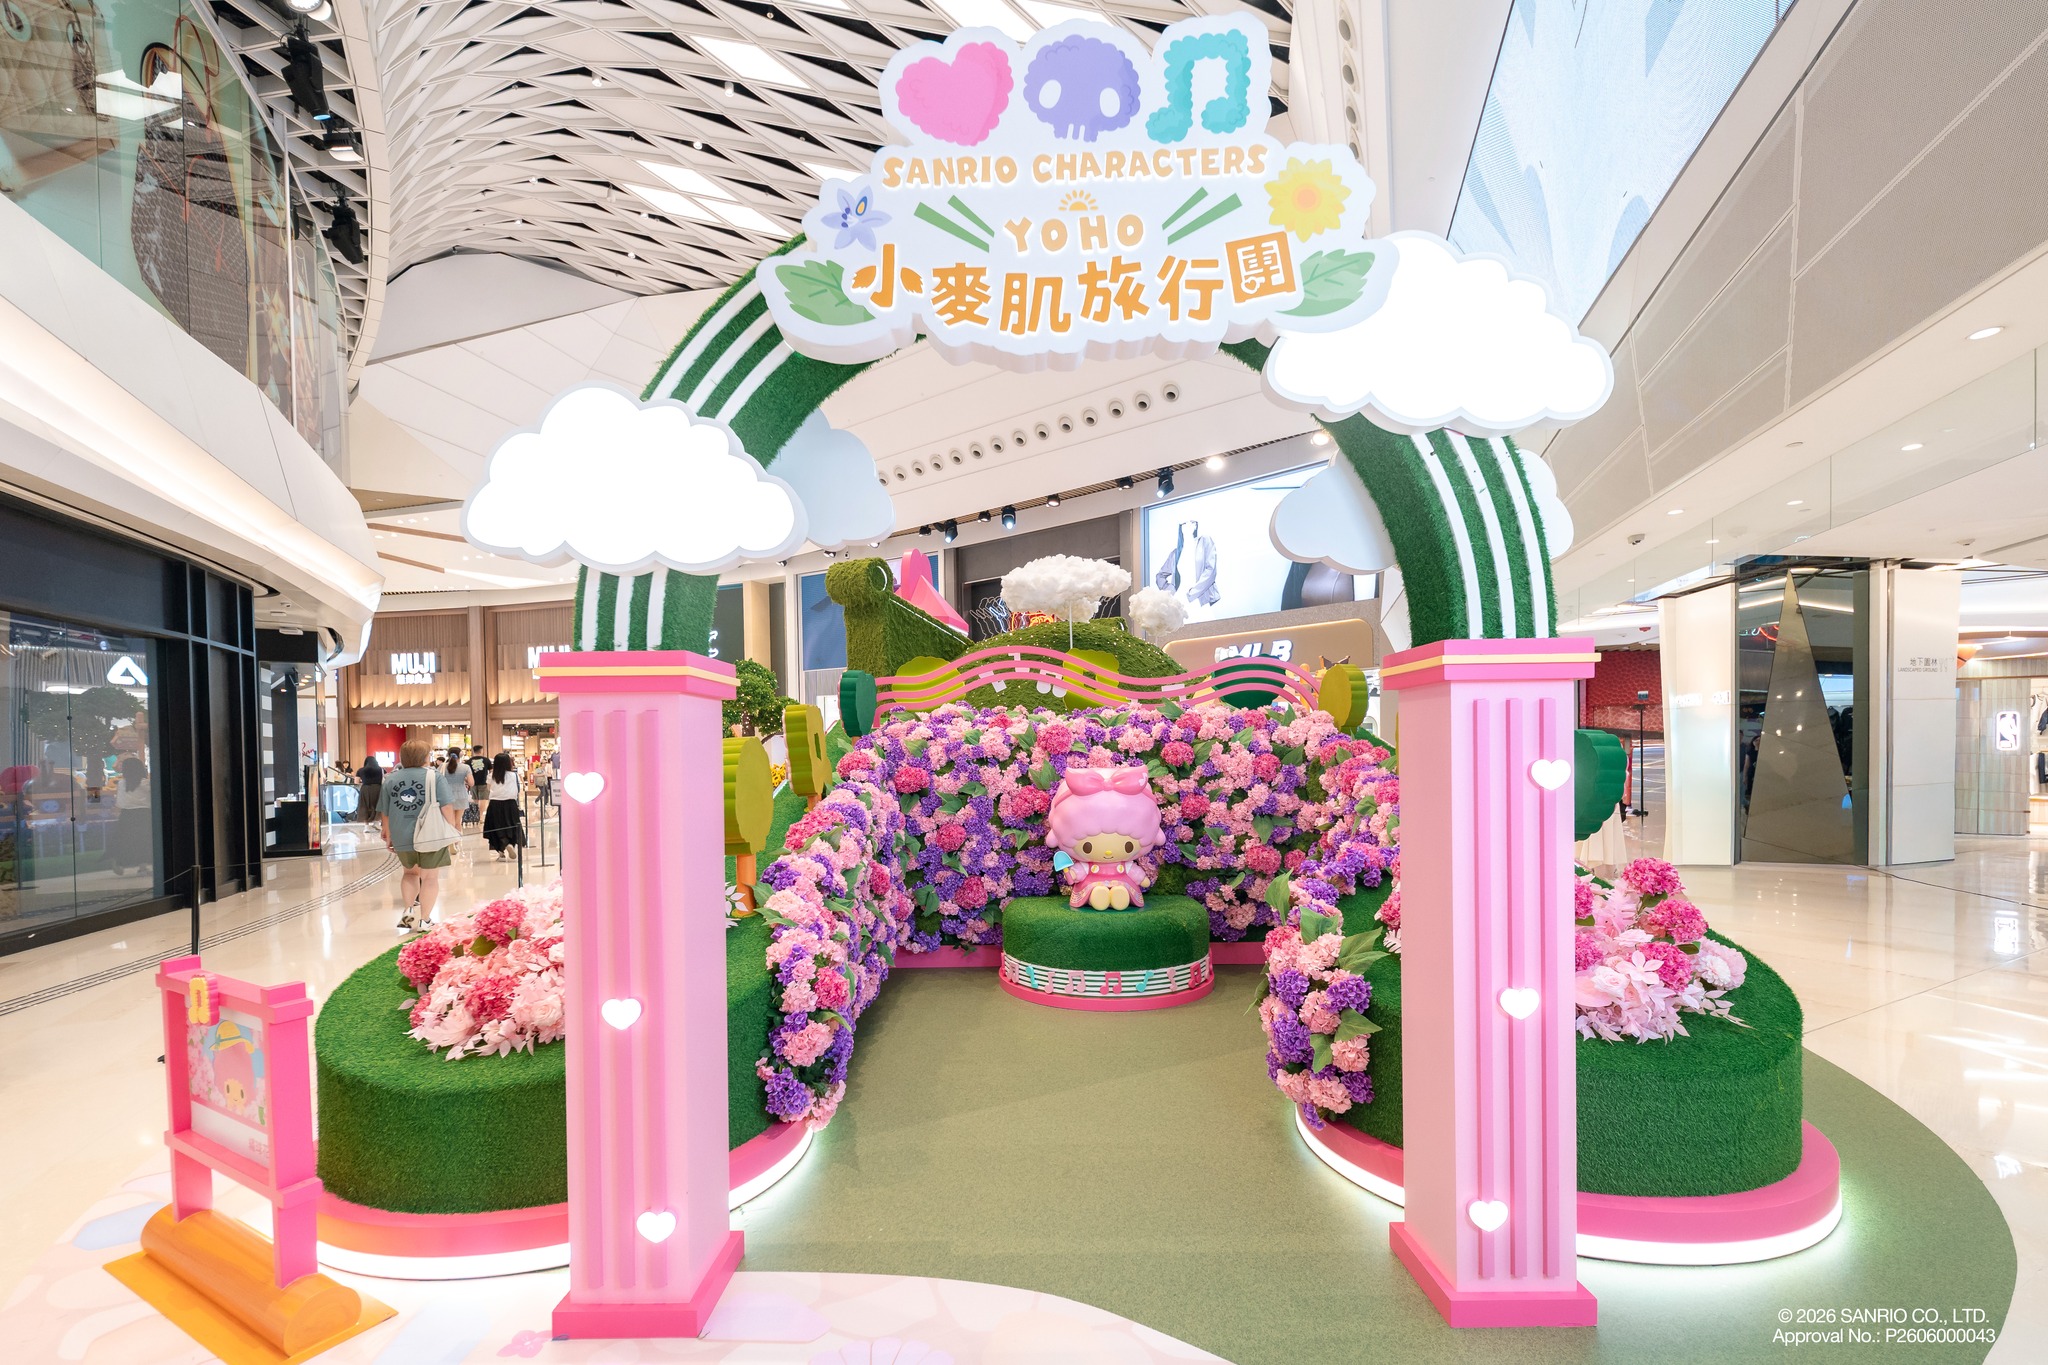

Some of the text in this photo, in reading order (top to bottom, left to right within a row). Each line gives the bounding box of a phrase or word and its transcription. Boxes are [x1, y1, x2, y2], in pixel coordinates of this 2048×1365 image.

[882, 144, 1268, 188] SANRIO CHARACTERS
[1004, 213, 1144, 252] YOHO
[851, 231, 1297, 335] 小麥肌旅行團
[391, 652, 436, 674] MUJI
[411, 780, 426, 796] YOU
